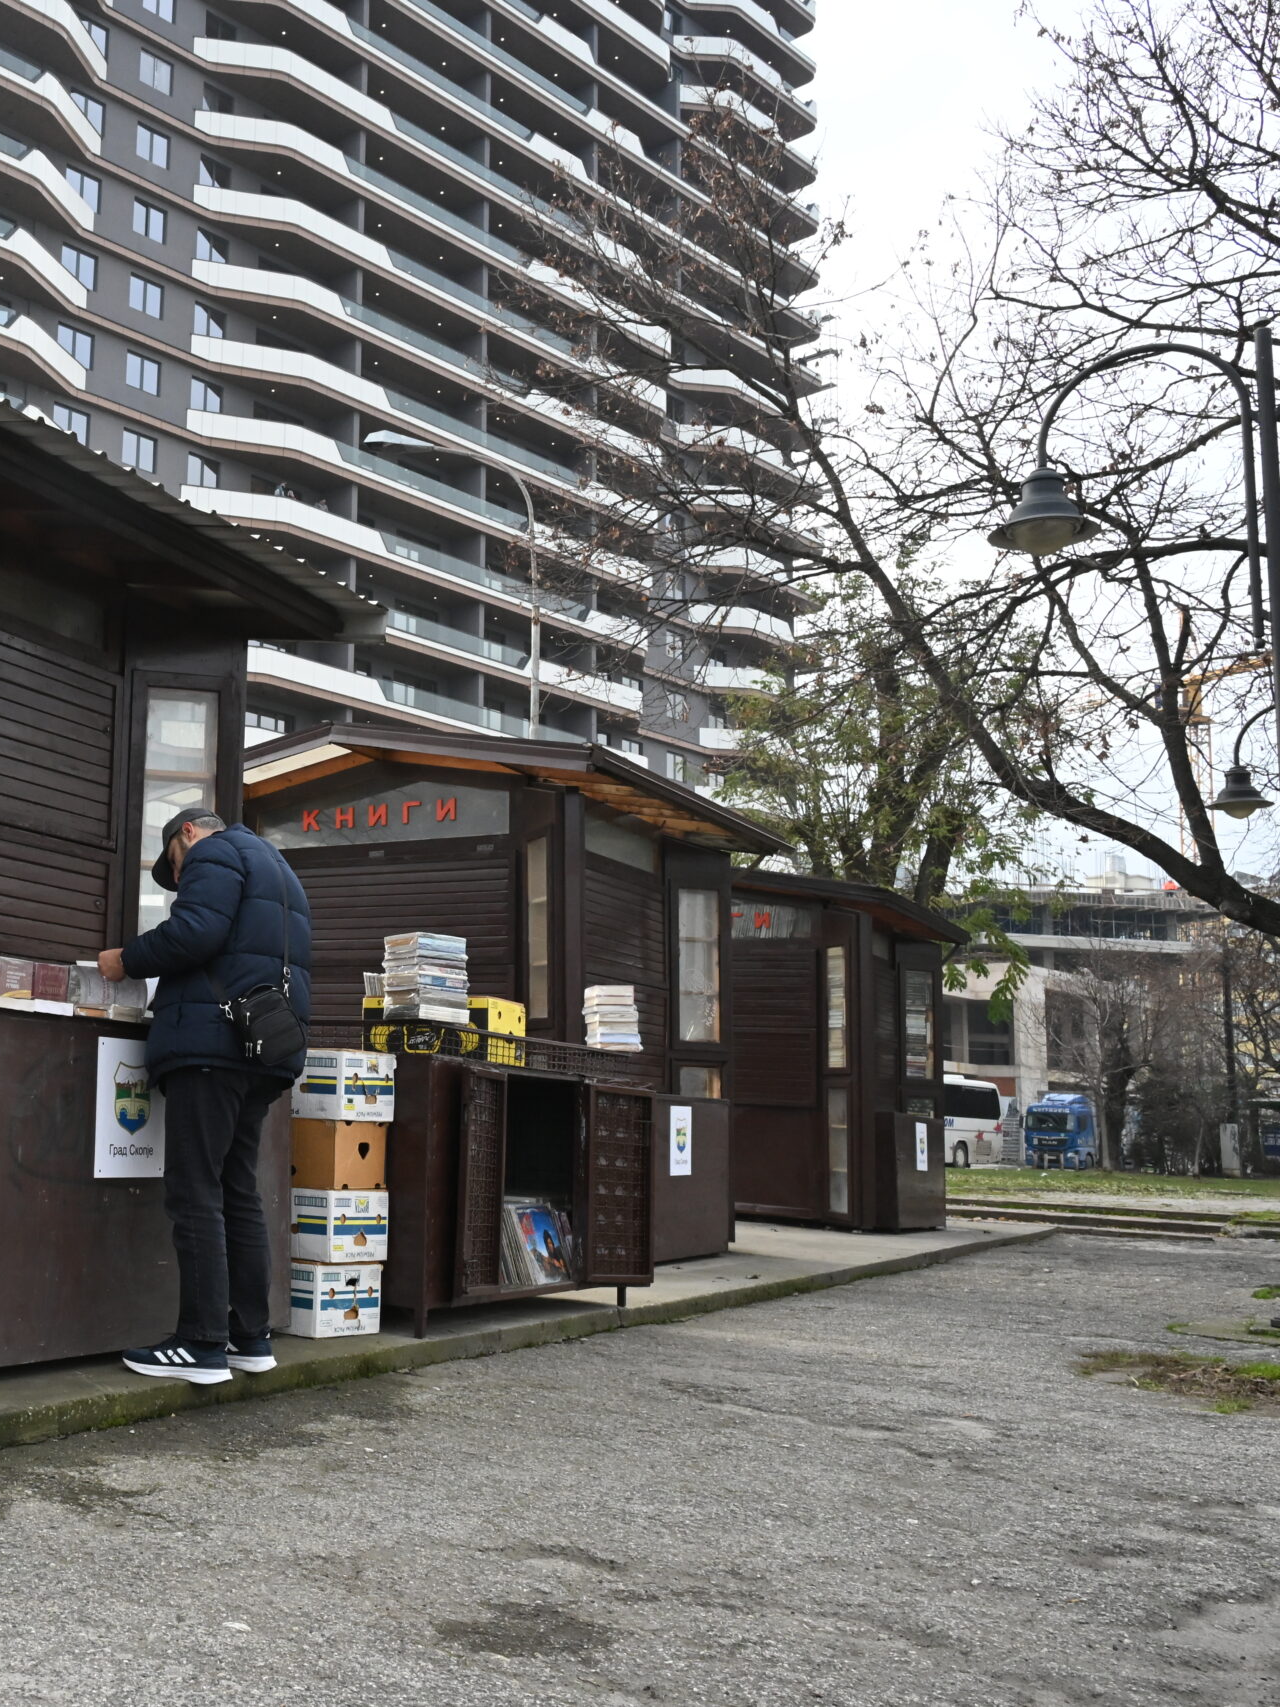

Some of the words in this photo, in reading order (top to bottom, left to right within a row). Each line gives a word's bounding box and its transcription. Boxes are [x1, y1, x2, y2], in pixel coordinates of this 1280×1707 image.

[302, 797, 457, 832] КНИГИ
[109, 1143, 128, 1158] Град
[129, 1143, 154, 1159] Скопје
